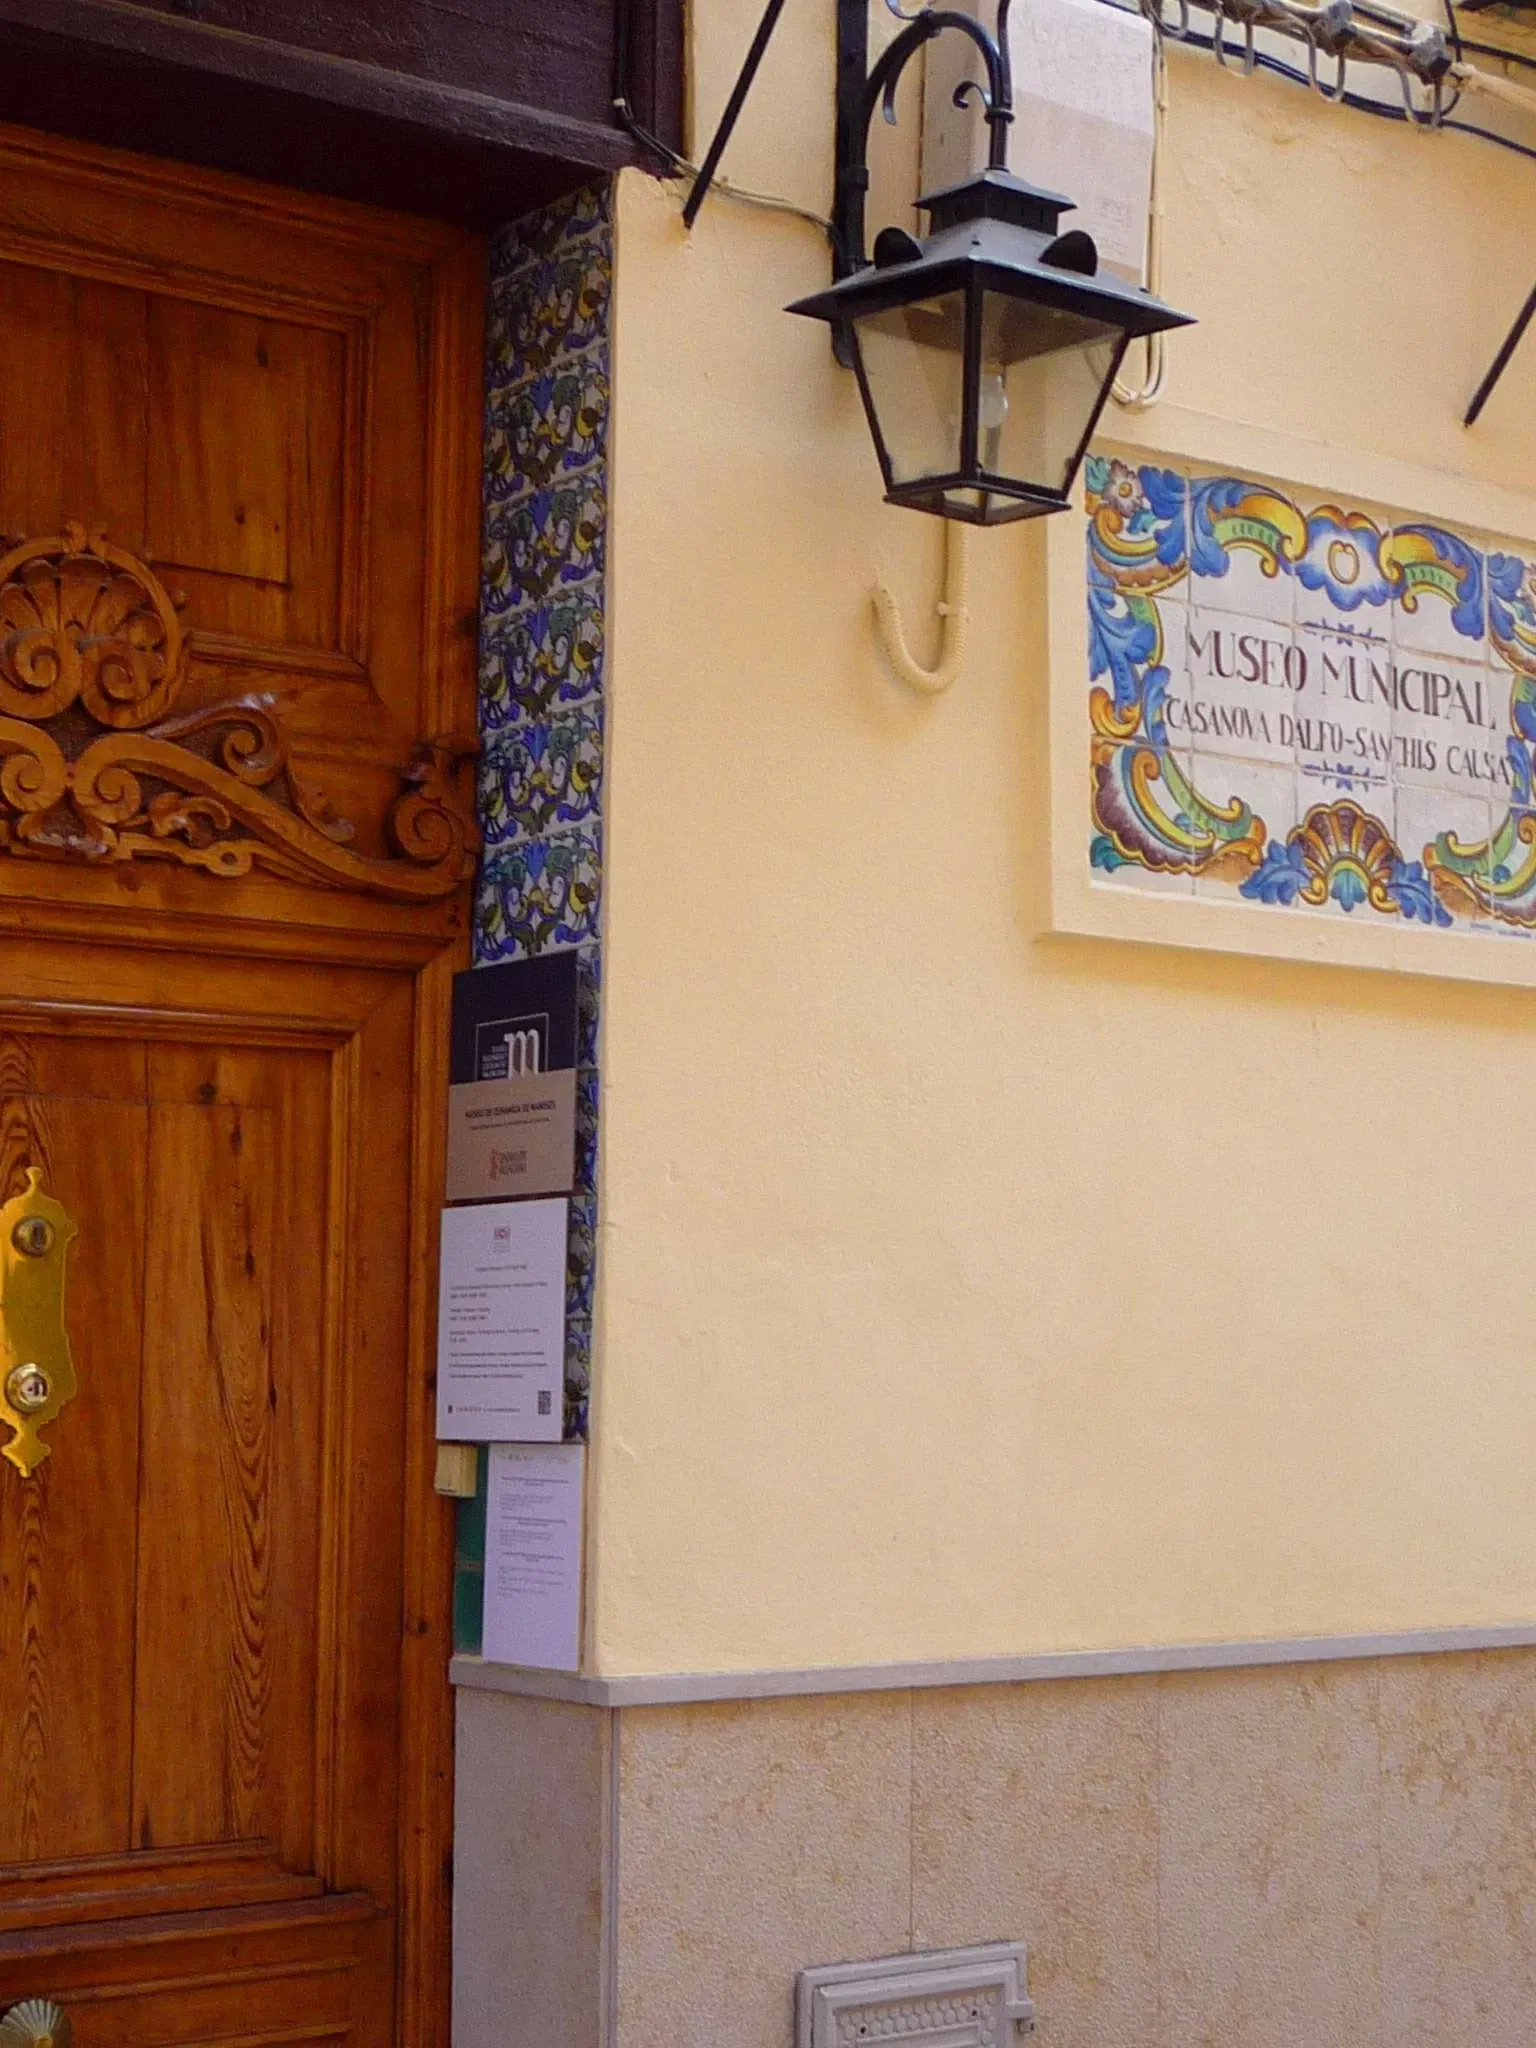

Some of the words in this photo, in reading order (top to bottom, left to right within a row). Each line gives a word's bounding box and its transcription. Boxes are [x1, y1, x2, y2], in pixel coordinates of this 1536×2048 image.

[1183, 629, 1308, 692] MUSEO
[1320, 651, 1497, 731] MUNICIPAL
[1166, 697, 1272, 745] CASANOVA
